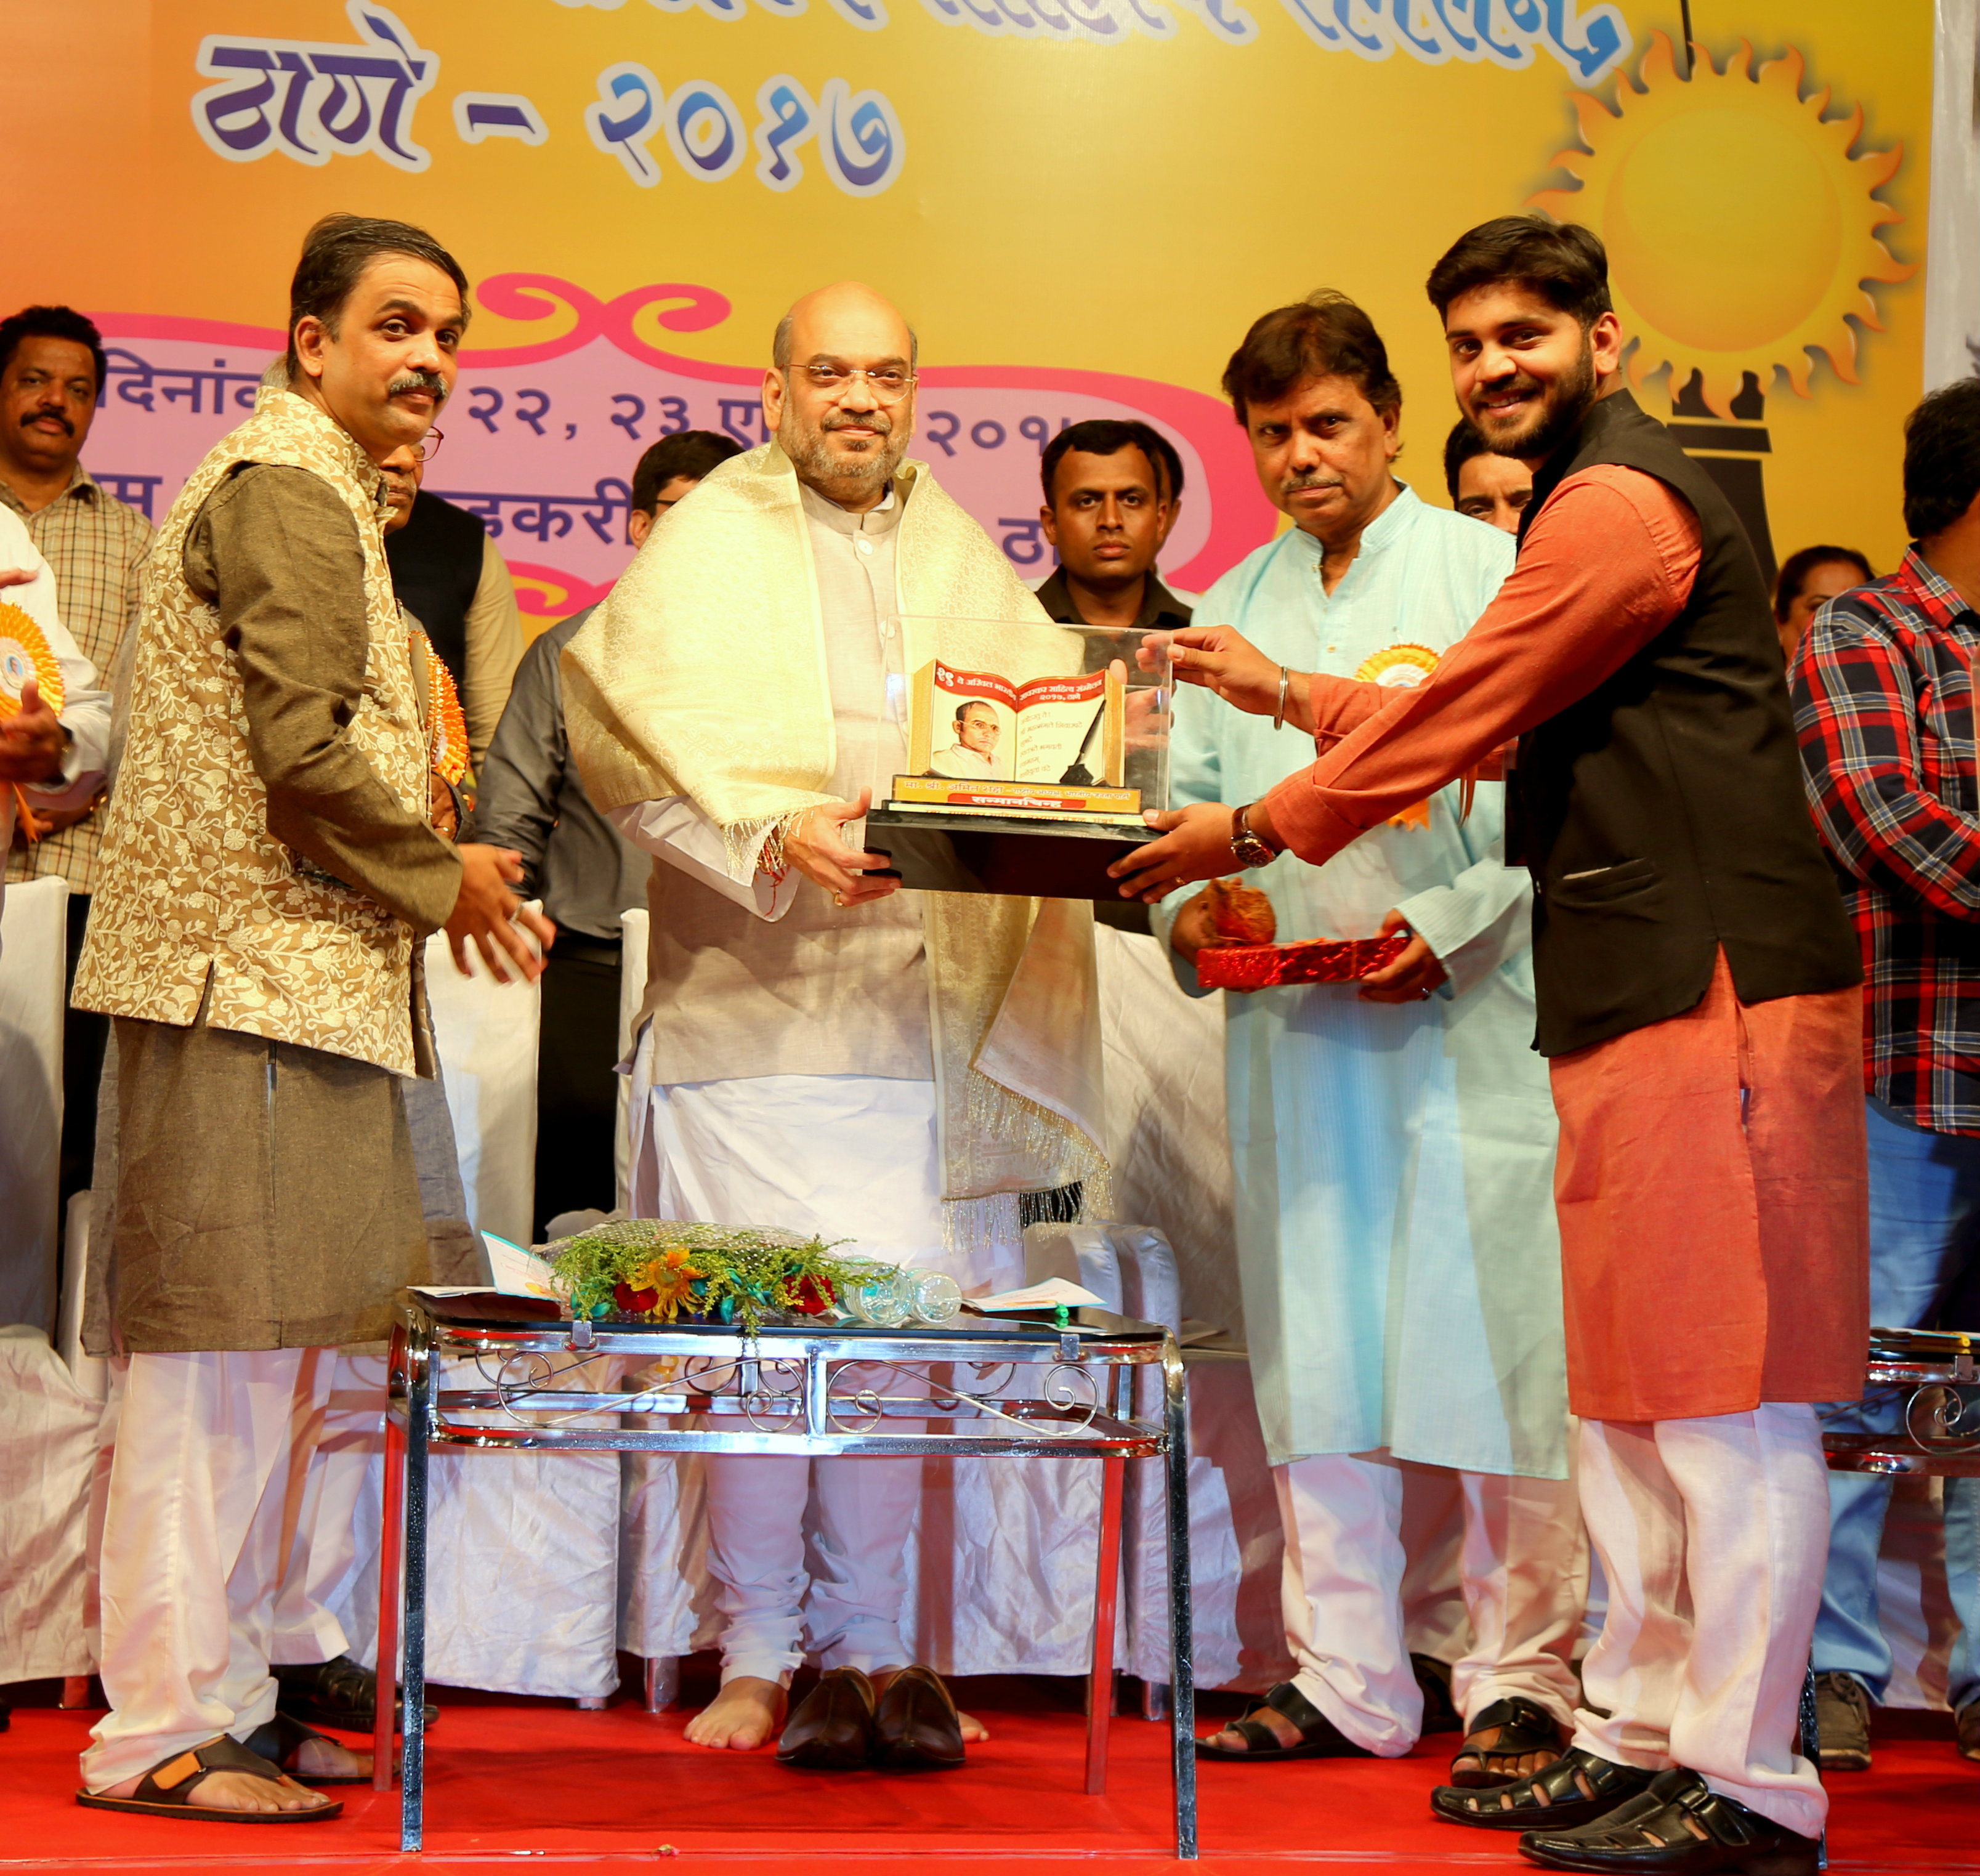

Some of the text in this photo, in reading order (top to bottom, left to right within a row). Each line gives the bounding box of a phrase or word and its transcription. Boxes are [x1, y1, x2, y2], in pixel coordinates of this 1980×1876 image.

[200, 9, 430, 165] ठाणे
[597, 71, 894, 187] २०१७
[926, 410, 1072, 458] २०१
[429, 477, 642, 546] डकरी
[966, 677, 993, 688] अखिल
[994, 682, 1017, 701] भारतीय
[1048, 684, 1075, 693] साहित्य
[1067, 692, 1081, 700] ठाणे
[926, 780, 945, 790] श्री.
[948, 782, 980, 793] अमित
[971, 796, 1062, 809] सन्मानचिन्ह
